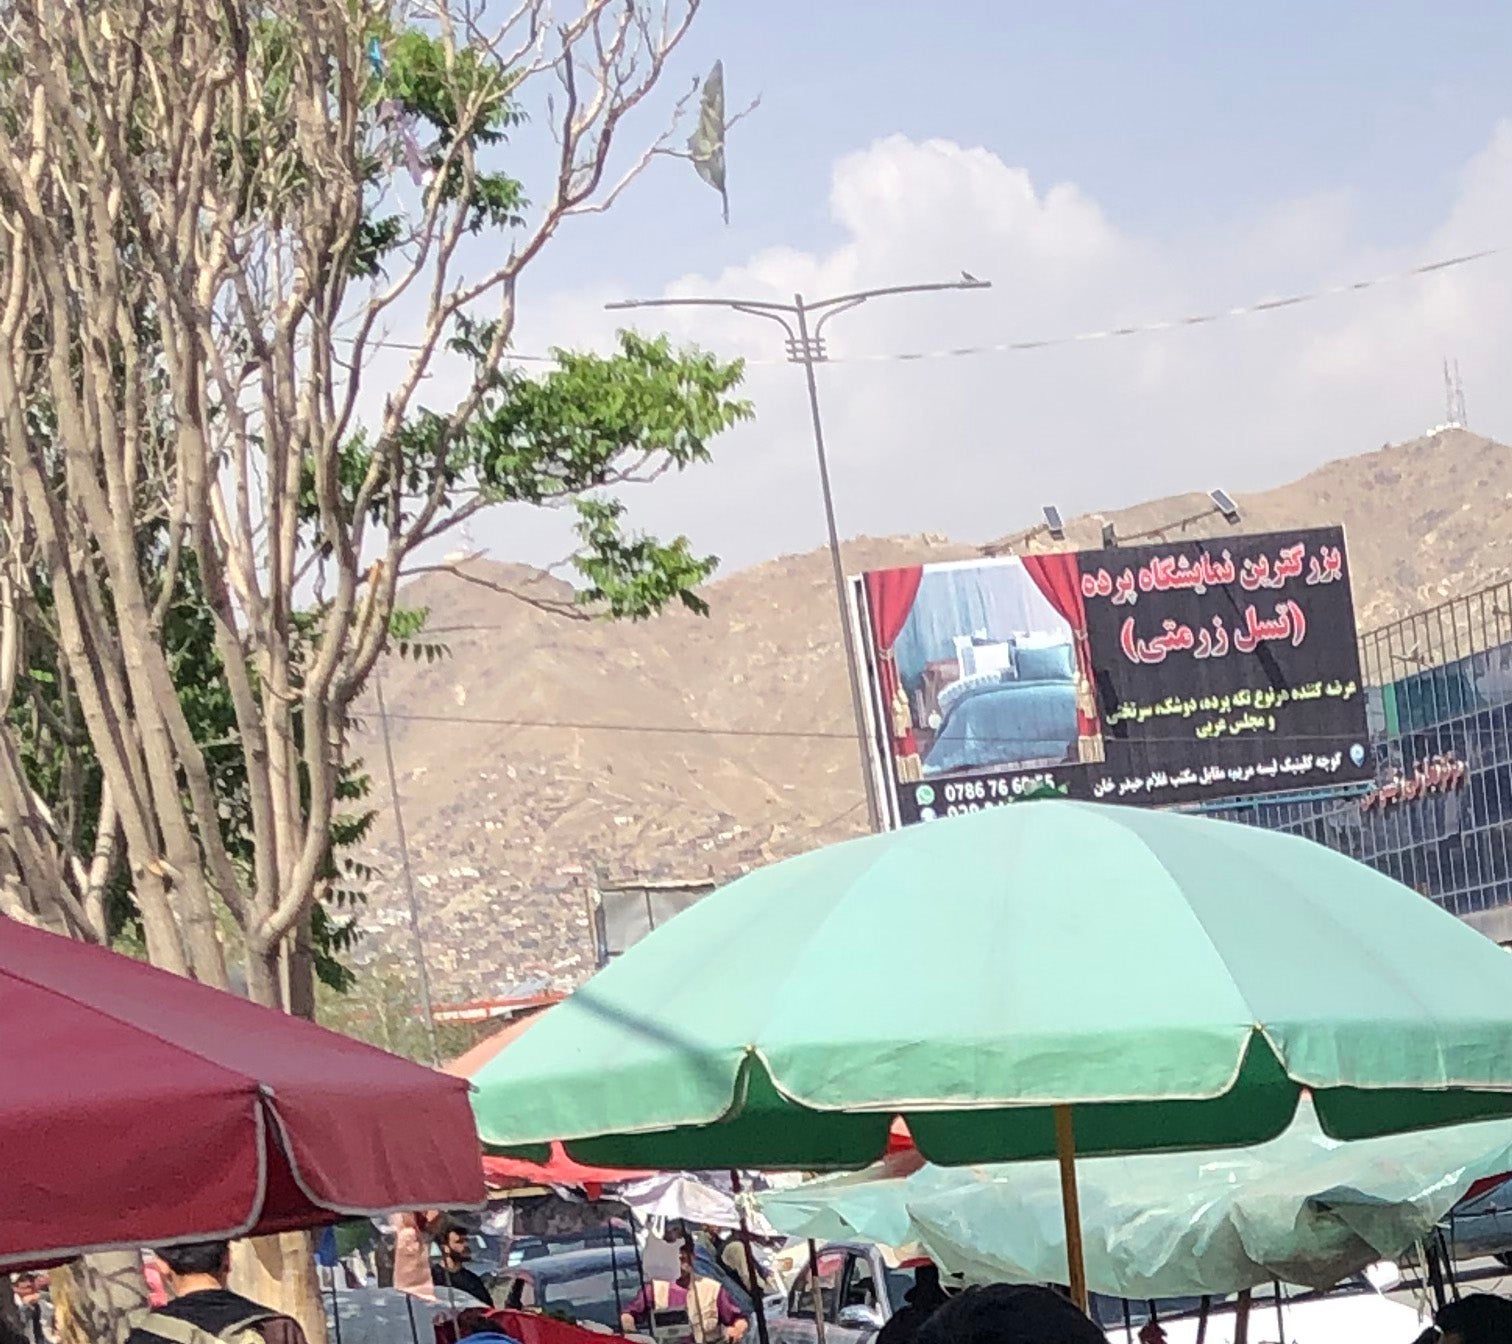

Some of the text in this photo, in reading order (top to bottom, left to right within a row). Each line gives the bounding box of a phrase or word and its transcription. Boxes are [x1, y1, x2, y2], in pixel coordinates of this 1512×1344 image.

[1081, 567, 1138, 605] پرده
[1139, 549, 1235, 595] نمایشگاه
[1268, 713, 1276, 732] و
[944, 779, 986, 802] 0786
[987, 778, 1009, 798] 76
